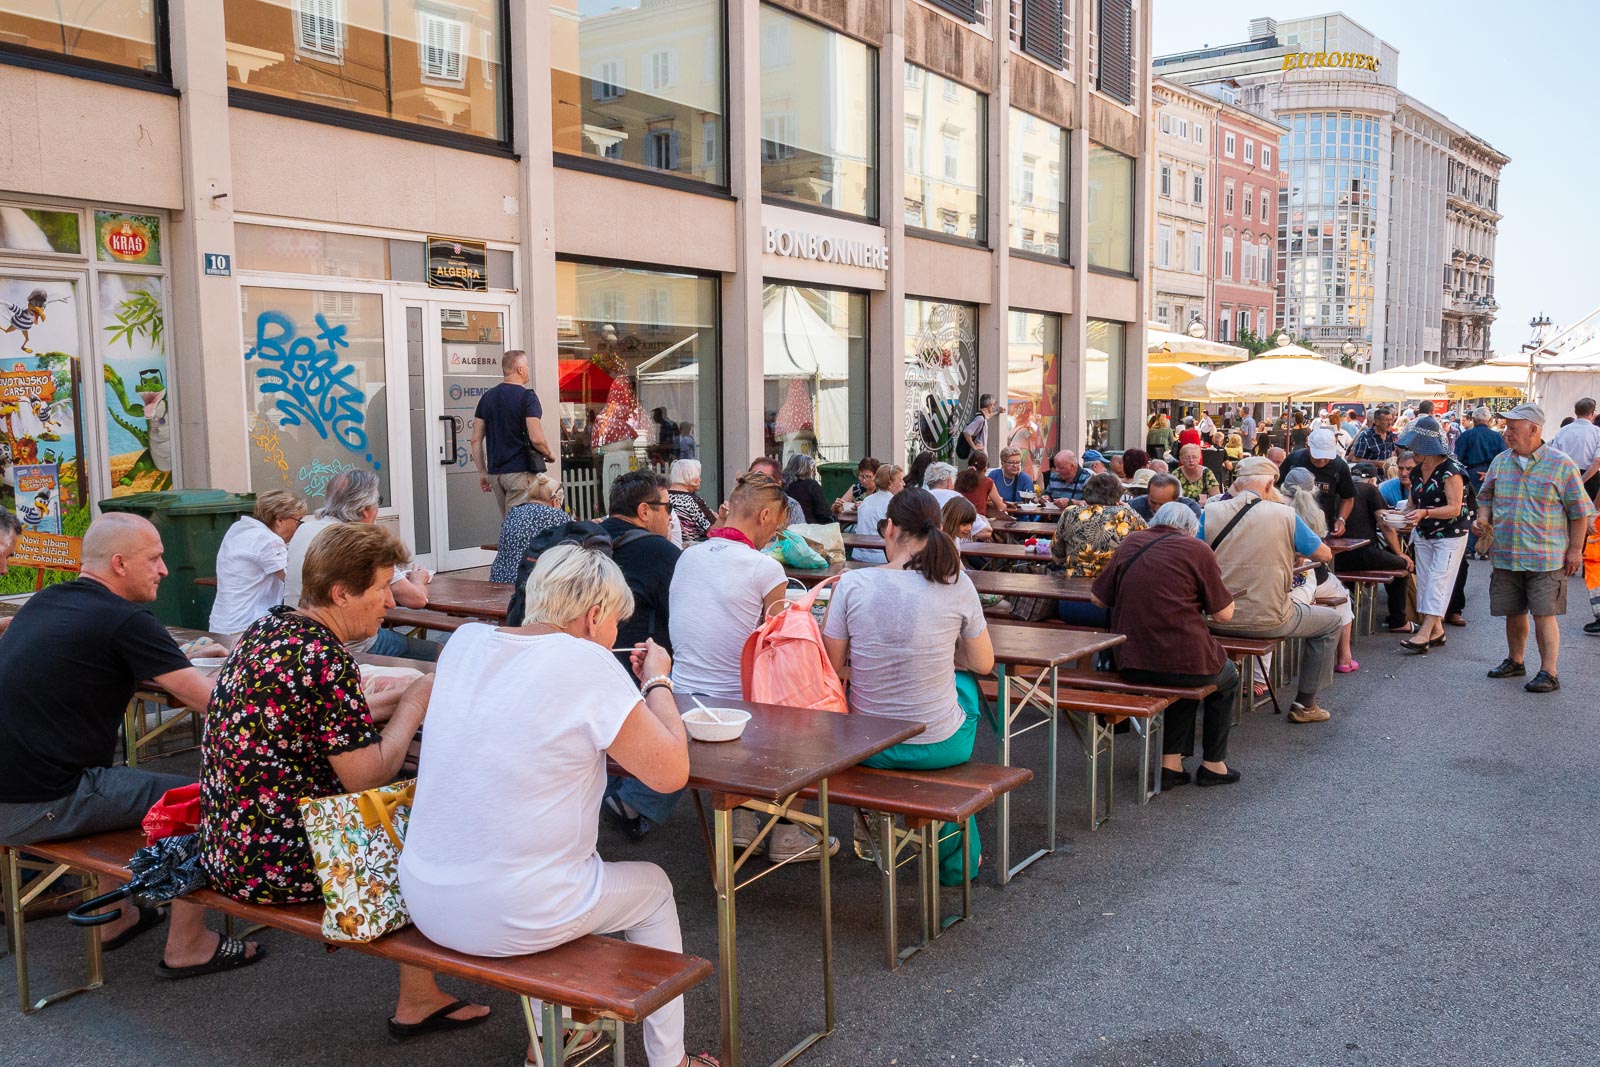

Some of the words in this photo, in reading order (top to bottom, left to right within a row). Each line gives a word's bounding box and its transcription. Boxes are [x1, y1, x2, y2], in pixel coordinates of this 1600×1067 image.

[1281, 52, 1380, 72] EUROHERC
[112, 235, 143, 252] KRAŠ
[763, 227, 889, 270] BONBONNIERE
[210, 255, 226, 270] 10
[437, 266, 480, 280] ALGEBRA
[461, 357, 498, 366] ALGEBRA
[0, 375, 49, 387] IVOTINJSKO
[4, 386, 42, 397] CARSTVO
[19, 543, 39, 553] Nove
[22, 536, 40, 545] Novi
[42, 538, 69, 549] album!
